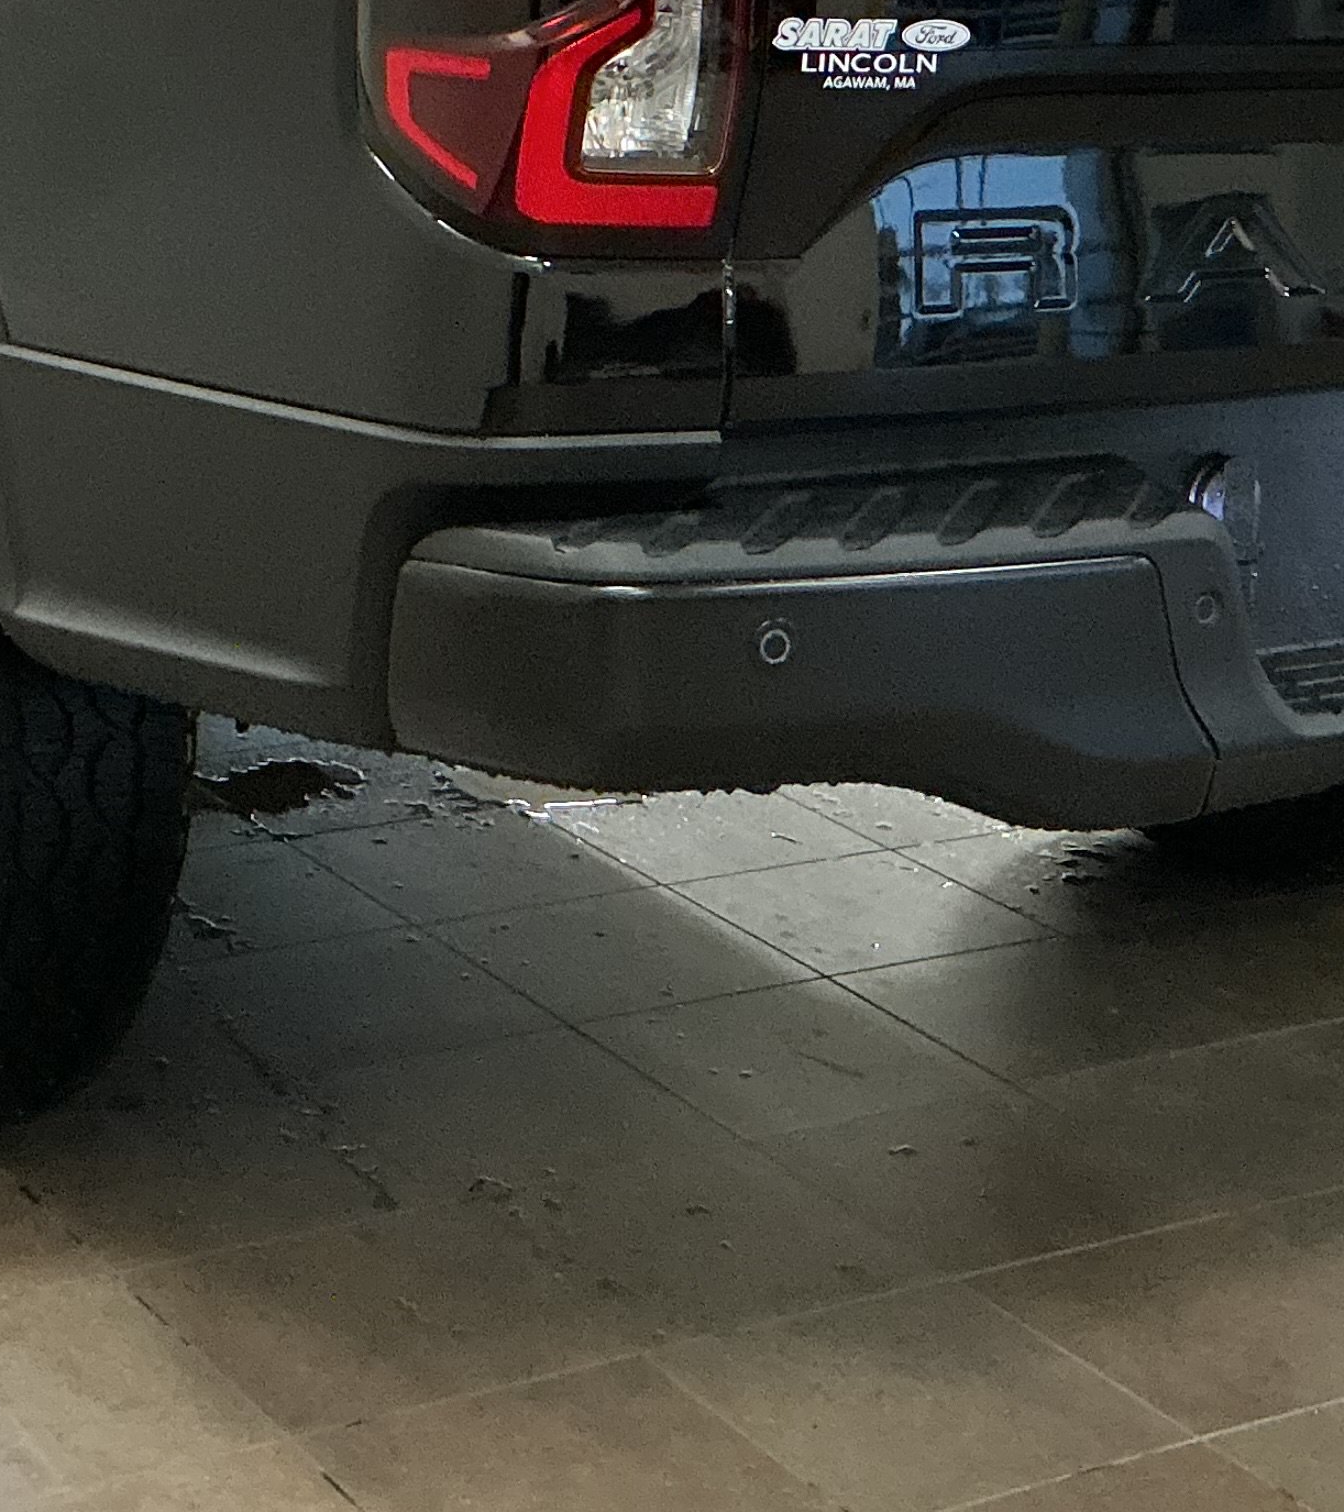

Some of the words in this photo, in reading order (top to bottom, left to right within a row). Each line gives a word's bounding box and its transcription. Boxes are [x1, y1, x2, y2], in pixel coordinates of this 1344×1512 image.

[772, 17, 898, 51] SARAT
[914, 24, 956, 45] Ford
[801, 52, 939, 74] LINCOLN
[822, 75, 891, 90] AGAWAM,
[894, 76, 917, 89] MA
